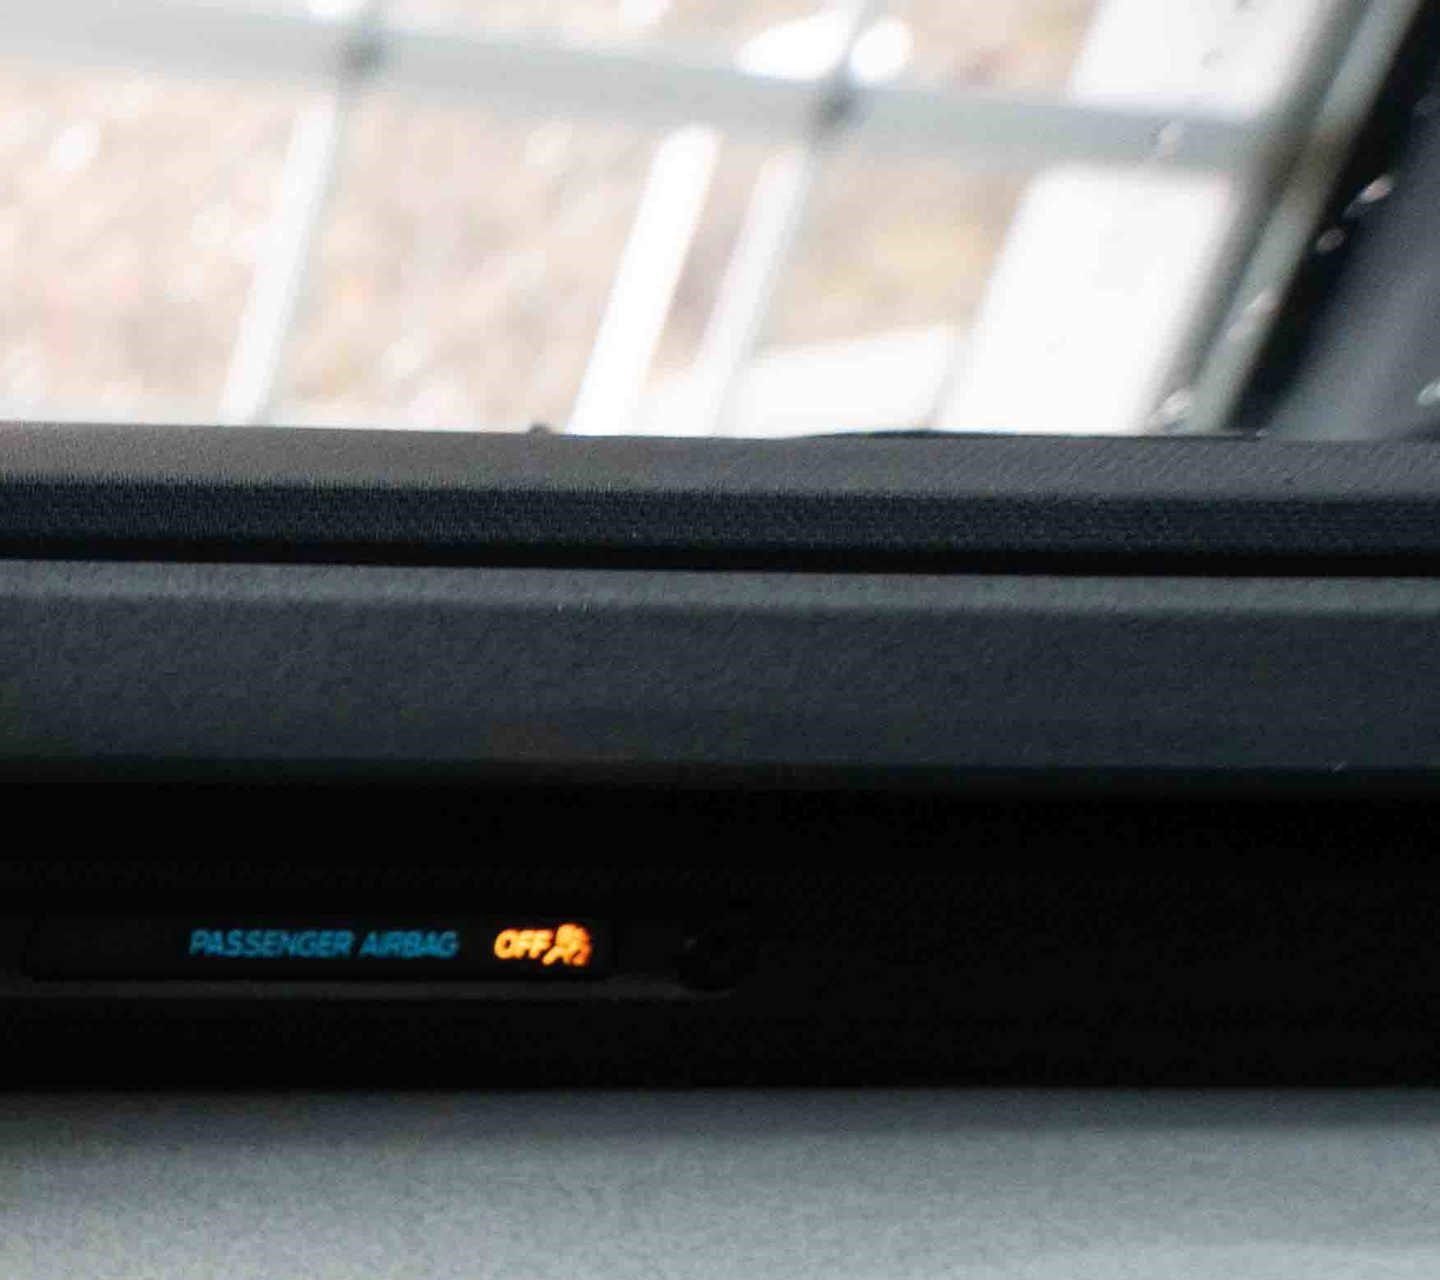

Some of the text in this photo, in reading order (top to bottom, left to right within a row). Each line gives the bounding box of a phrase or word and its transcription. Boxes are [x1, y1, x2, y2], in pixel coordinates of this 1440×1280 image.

[188, 926, 553, 962] PASSENGER AIRBAG OFF
